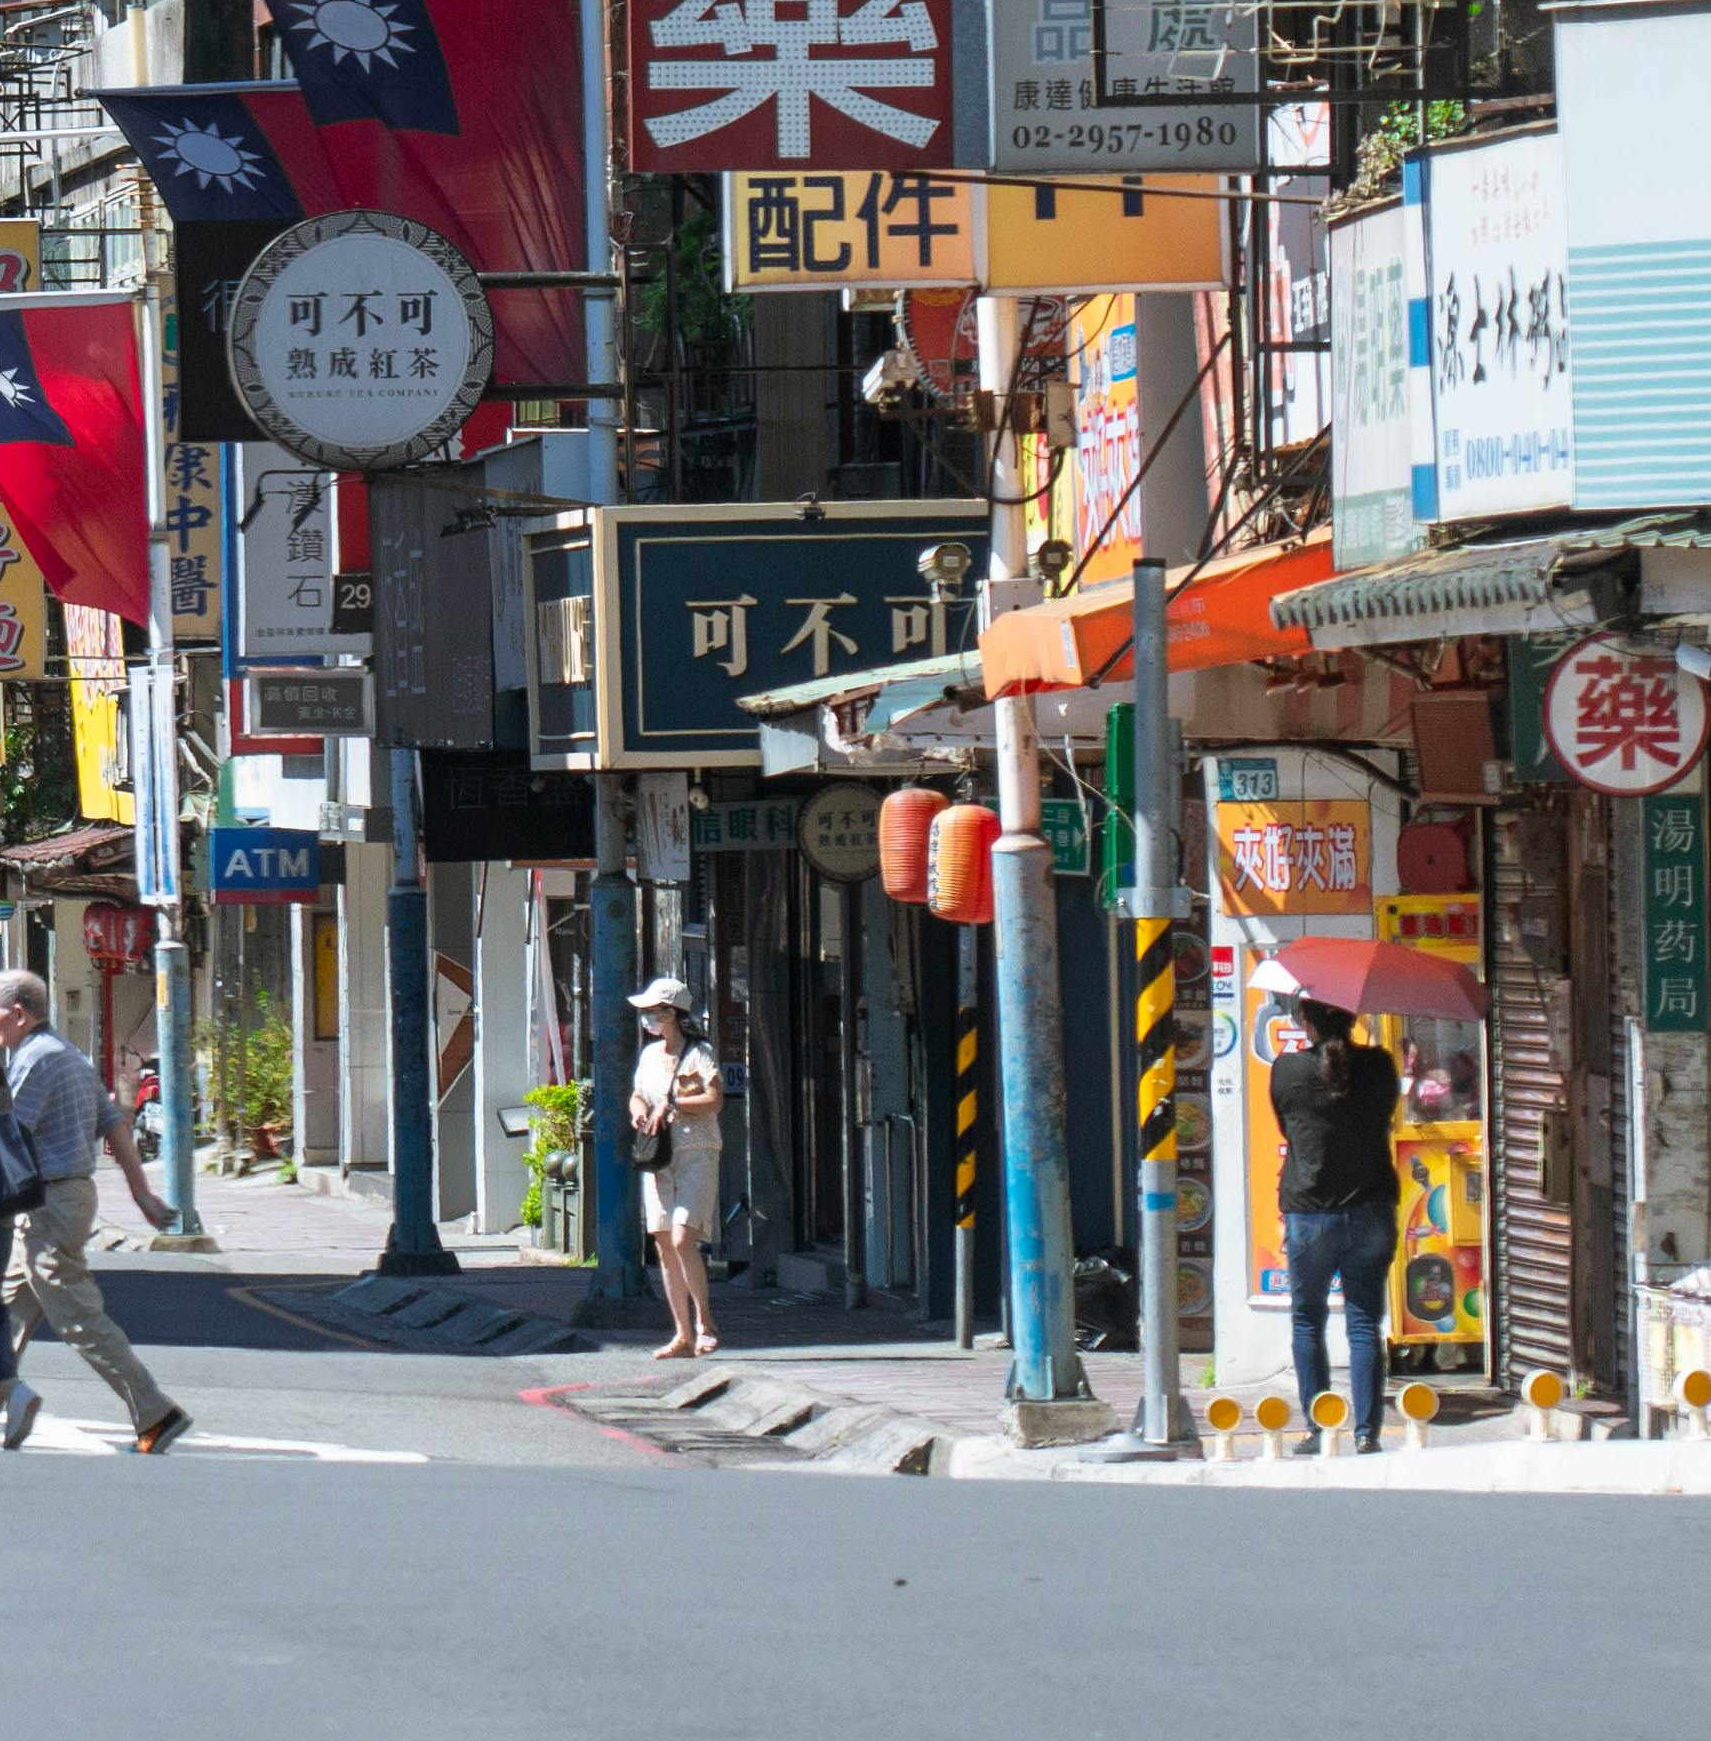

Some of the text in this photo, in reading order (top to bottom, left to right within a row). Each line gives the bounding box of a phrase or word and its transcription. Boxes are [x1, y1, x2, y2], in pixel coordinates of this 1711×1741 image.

[1012, 116, 1236, 152] 02-2957-1980
[748, 173, 960, 273] 配件
[285, 289, 439, 338] 可不可
[285, 347, 440, 380] 熟成紅茶
[379, 388, 439, 398] COMPANY
[685, 592, 950, 678] 可不可
[263, 685, 339, 703] 高價回收
[1575, 657, 1681, 770] 藥
[1235, 770, 1274, 796] 313
[224, 847, 310, 878] ATM
[1232, 823, 1357, 893] 夾好夾滿
[1654, 809, 1700, 1019] 湯明药局
